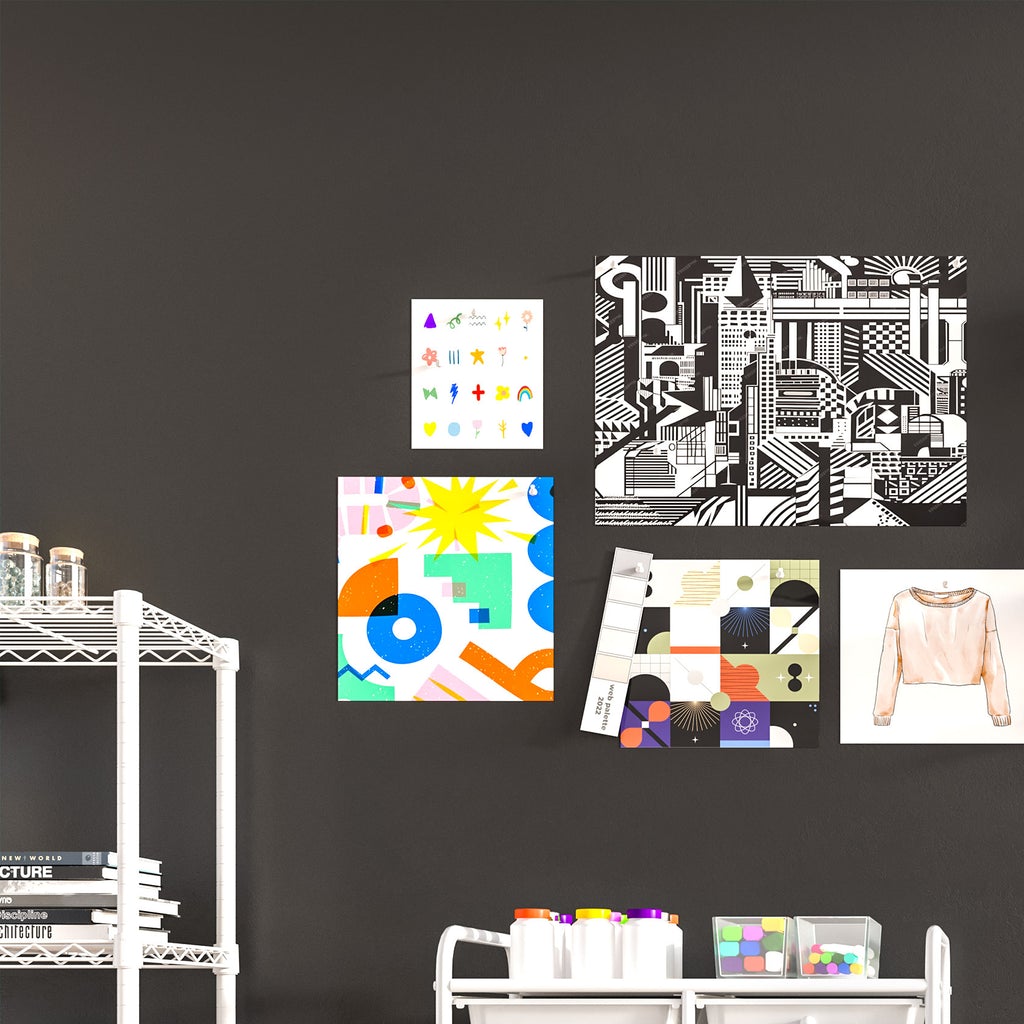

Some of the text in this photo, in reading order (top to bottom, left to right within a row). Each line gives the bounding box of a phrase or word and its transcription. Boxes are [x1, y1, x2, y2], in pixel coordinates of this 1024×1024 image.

[594, 696, 604, 715] 2022
[601, 684, 615, 731] web palette
[0, 910, 48, 921] iscipline
